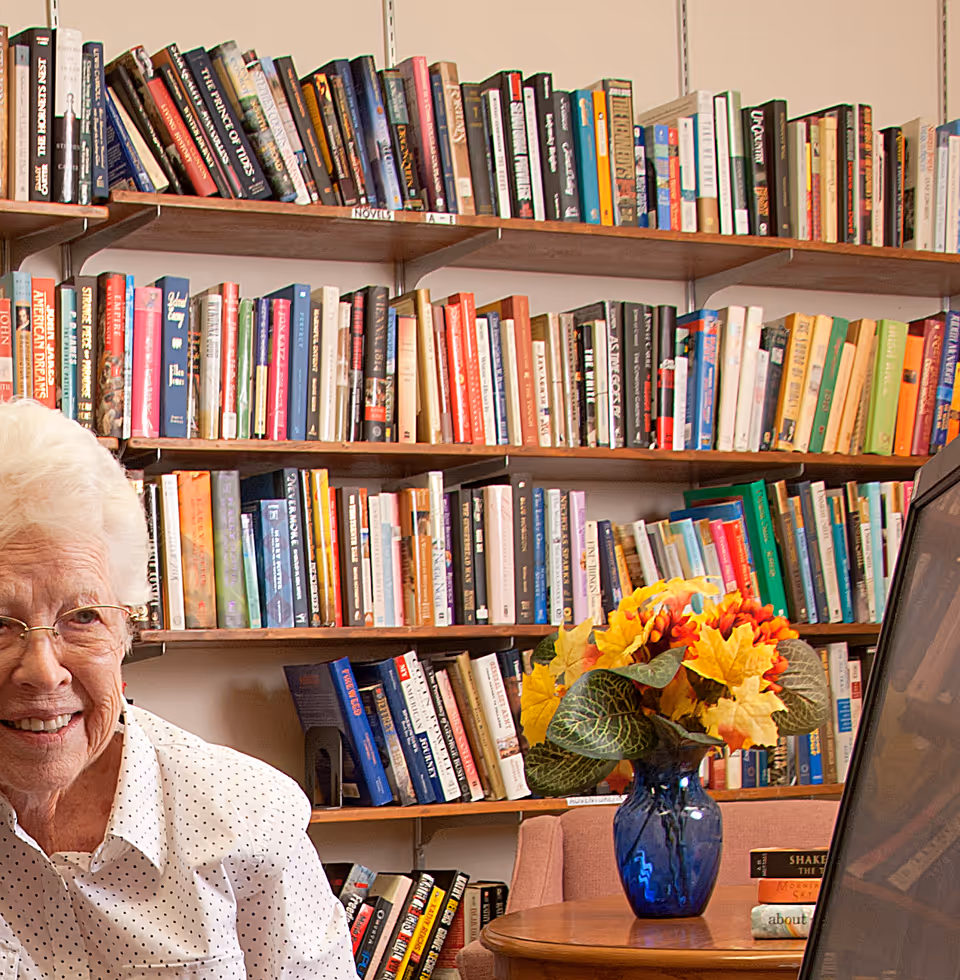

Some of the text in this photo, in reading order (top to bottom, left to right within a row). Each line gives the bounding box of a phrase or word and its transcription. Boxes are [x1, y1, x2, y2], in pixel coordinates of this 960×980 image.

[38, 58, 47, 84] NEST
[160, 104, 192, 163] LIVING HISTORY
[201, 67, 255, 177] THE PRINCE OF TIDES
[250, 100, 268, 132] SOUTH
[37, 136, 46, 156] THE
[612, 98, 633, 179] THE KENNEDYS
[354, 208, 435, 224] NOVELS A
[0, 310, 10, 345] JOHN
[113, 294, 122, 336] EMPIRE
[33, 290, 46, 400] AMERICAN DREAMS
[82, 286, 92, 398] STRANGE PIECE PARADISE
[584, 348, 593, 369] THE
[374, 350, 386, 372] 1814
[611, 374, 620, 402] GOES
[286, 474, 298, 546] NEVERMORE
[432, 550, 446, 608] Nora, Nora
[562, 548, 570, 584] SPARKS
[342, 668, 362, 716] FIREWEED
[490, 661, 512, 730] GENERAL ARMY
[398, 663, 436, 779] MY AMERICAN JOURNEY
[428, 672, 466, 781] The GEORGE BUSH
[450, 874, 468, 900] KATHY
[367, 910, 386, 944] OMERTA
[413, 902, 437, 952] KATHY REICHS
[441, 898, 459, 926] REICHS
[768, 913, 807, 924] about
[431, 927, 448, 952] GRAVE
